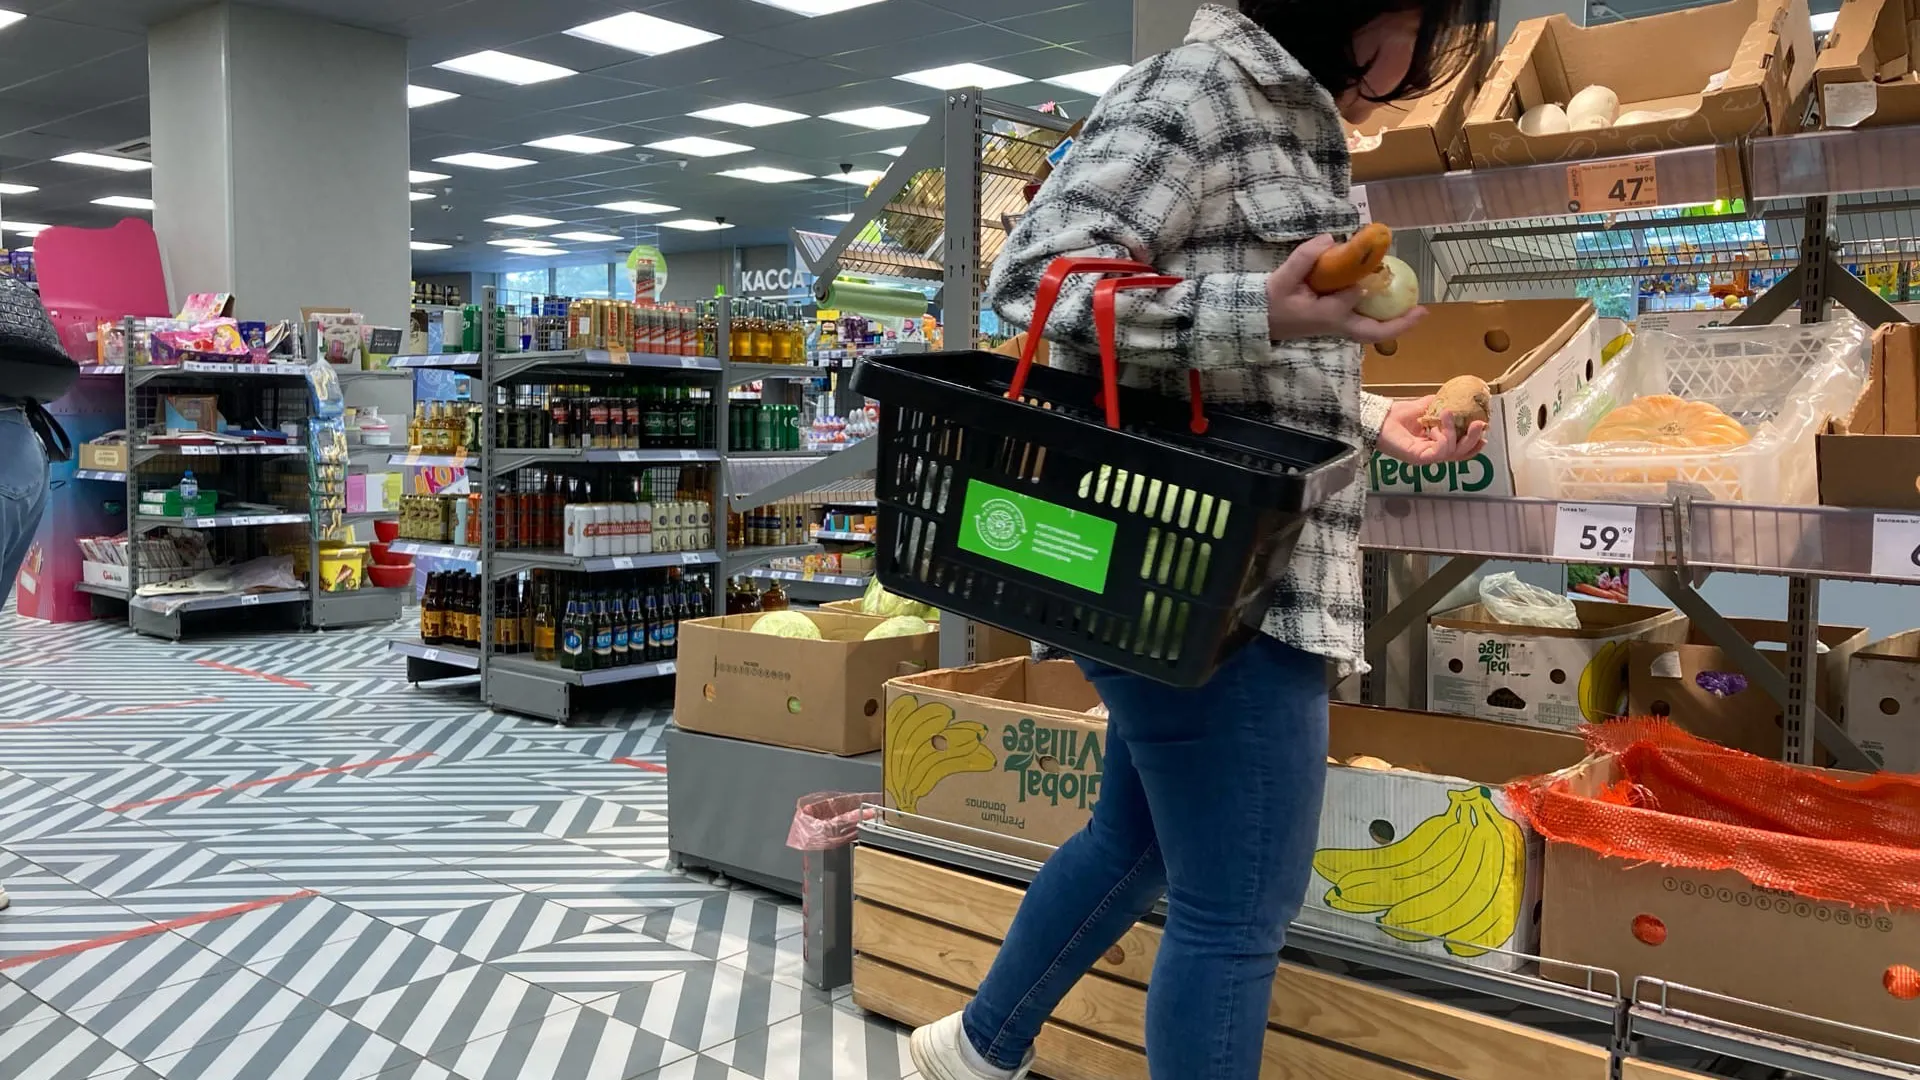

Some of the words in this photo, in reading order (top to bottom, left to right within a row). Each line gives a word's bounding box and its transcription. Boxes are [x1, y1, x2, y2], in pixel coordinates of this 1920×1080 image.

[1608, 177, 1644, 202] 47
[741, 268, 805, 292] КАССА
[1369, 451, 1495, 493] Global
[1580, 525, 1619, 551] 59
[1003, 719, 1104, 772] Village
[966, 798, 1006, 812] bananas
[981, 812, 1025, 829] Premium
